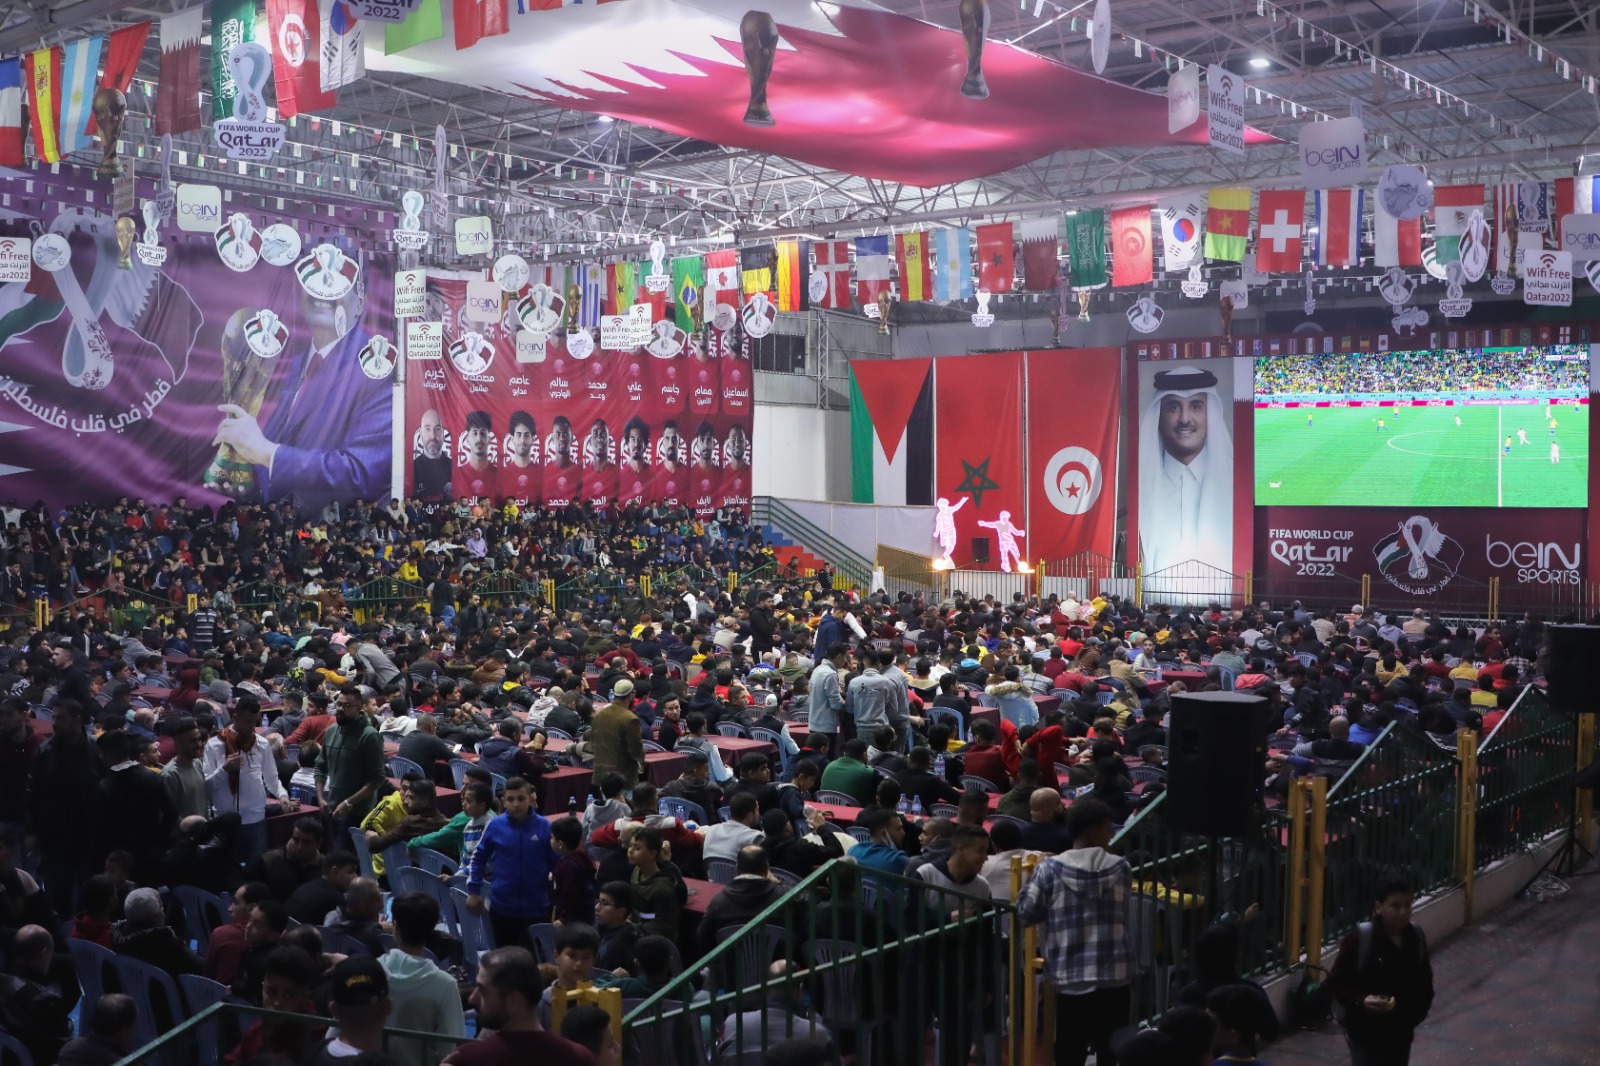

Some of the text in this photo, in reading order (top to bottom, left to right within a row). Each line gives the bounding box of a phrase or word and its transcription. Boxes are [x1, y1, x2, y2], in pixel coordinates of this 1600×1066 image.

[364, 5, 400, 19] 2022
[1210, 91, 1242, 116] Wifi Free
[218, 124, 235, 132] FIFA
[220, 132, 280, 150] Qatar
[1210, 127, 1244, 150] Qatar2022
[238, 148, 266, 156] 2022
[1305, 144, 1360, 166] beIN
[1328, 160, 1360, 172] SPORTS
[180, 200, 218, 216] beIN
[396, 234, 426, 244] Qatar
[458, 232, 488, 242] beIN
[9, 252, 29, 260] Free
[138, 248, 164, 260] Qatar
[1526, 268, 1570, 280] Wifi Free
[396, 286, 424, 295] Wifi Free
[1526, 281, 1549, 289] مجاني
[1526, 292, 1570, 302] Qatar2022
[396, 306, 424, 314] Qatar2022
[1441, 304, 1470, 312] Qatar
[409, 334, 440, 342] Wifi Free
[518, 342, 544, 352] beIN
[424, 368, 445, 380] كريم
[508, 375, 530, 386] عاصم
[550, 376, 568, 388] سالم
[588, 382, 607, 390] محمد
[470, 384, 488, 393] مشعل
[627, 382, 642, 392] علي
[662, 384, 680, 395] جاسم
[694, 386, 712, 396] همام
[142, 378, 172, 418] قطر
[109, 404, 142, 434] في
[71, 414, 106, 437] قلب
[468, 496, 478, 506] الد
[548, 498, 570, 506] محمد
[696, 496, 712, 506] نايف
[1269, 529, 1354, 540] FIFA WORLD CUP
[1270, 540, 1354, 566] Qatar
[1486, 533, 1580, 570] beIN
[1296, 563, 1335, 576] 2022
[1518, 568, 1580, 584] SPORTS
[1385, 574, 1451, 596] قطر في قلب فلسطين
